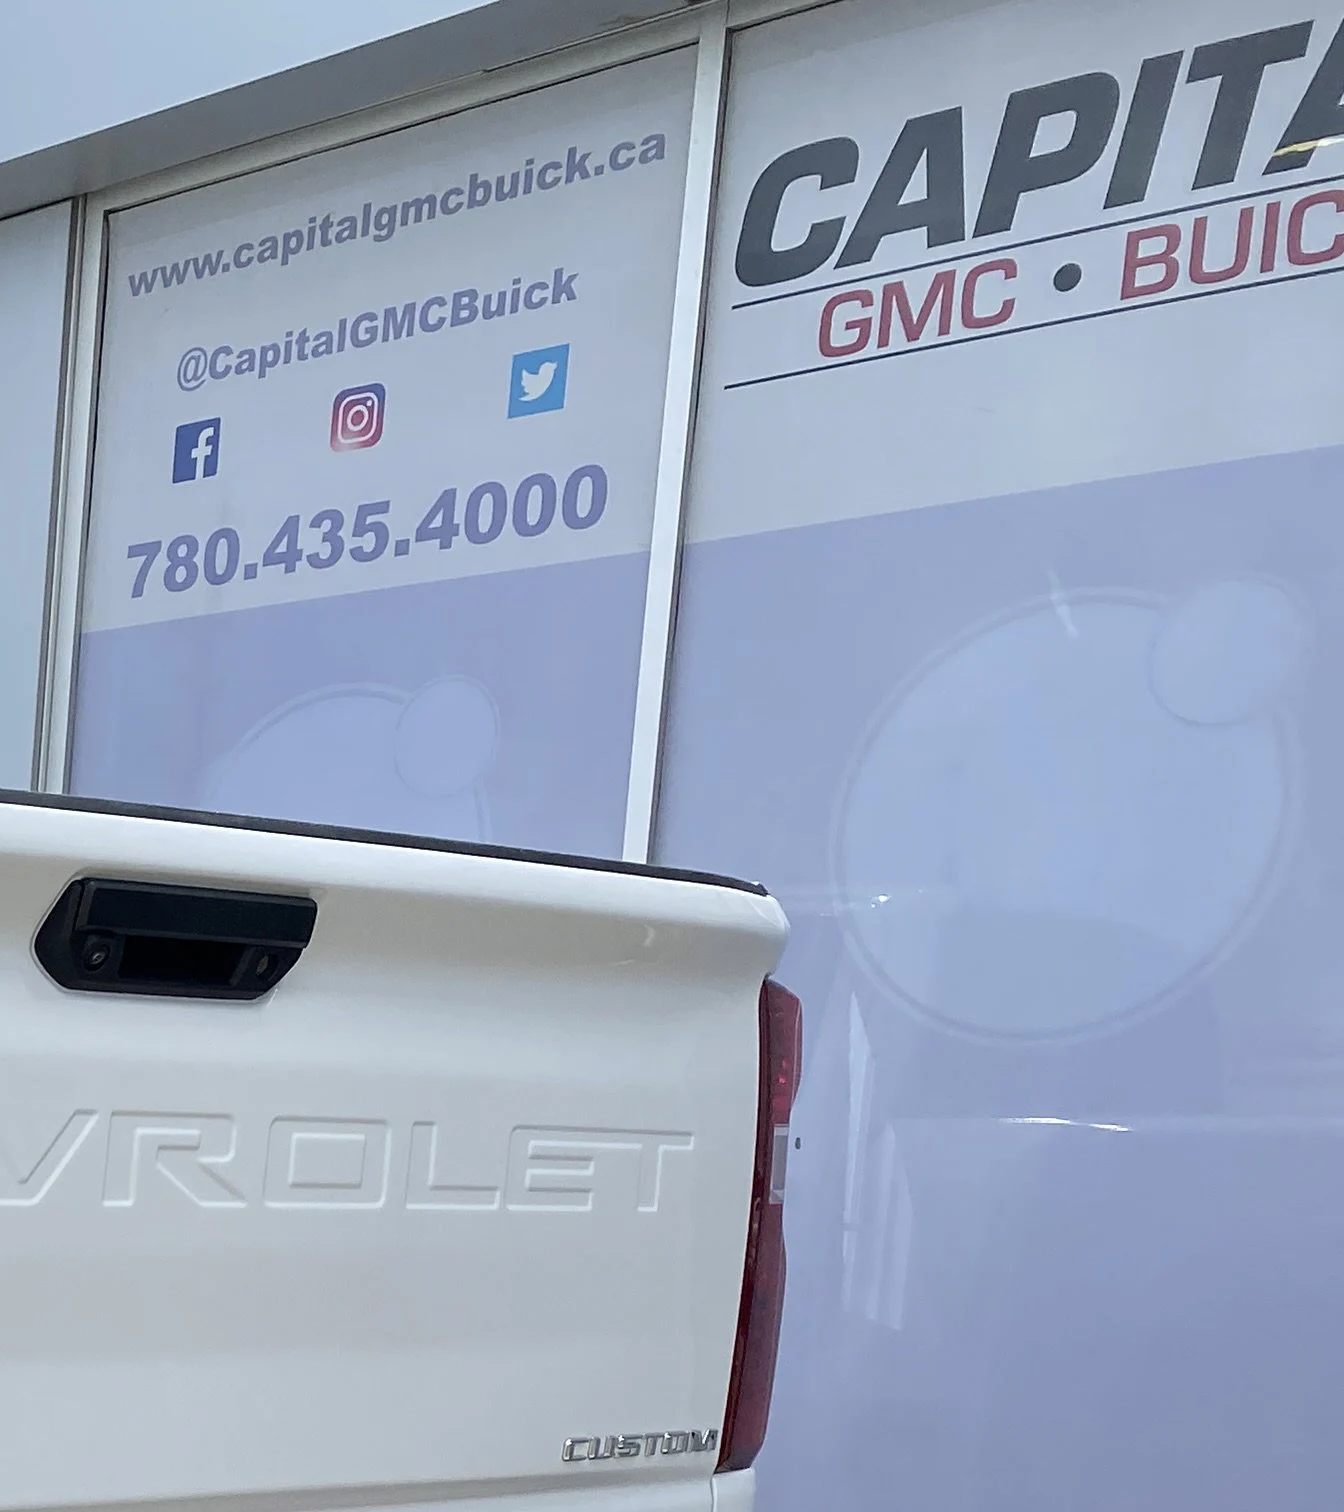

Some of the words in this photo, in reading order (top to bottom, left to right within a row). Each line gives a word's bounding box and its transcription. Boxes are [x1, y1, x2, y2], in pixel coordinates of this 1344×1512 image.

[127, 132, 667, 297] www.capitalgmcbuick.ca
[818, 257, 1018, 359] GMC
[1119, 189, 1344, 300] BUIC
[176, 266, 580, 391] @CapitalGMCBuick
[126, 464, 609, 599] 780.435.4000
[562, 1427, 718, 1462] CUSTOM
